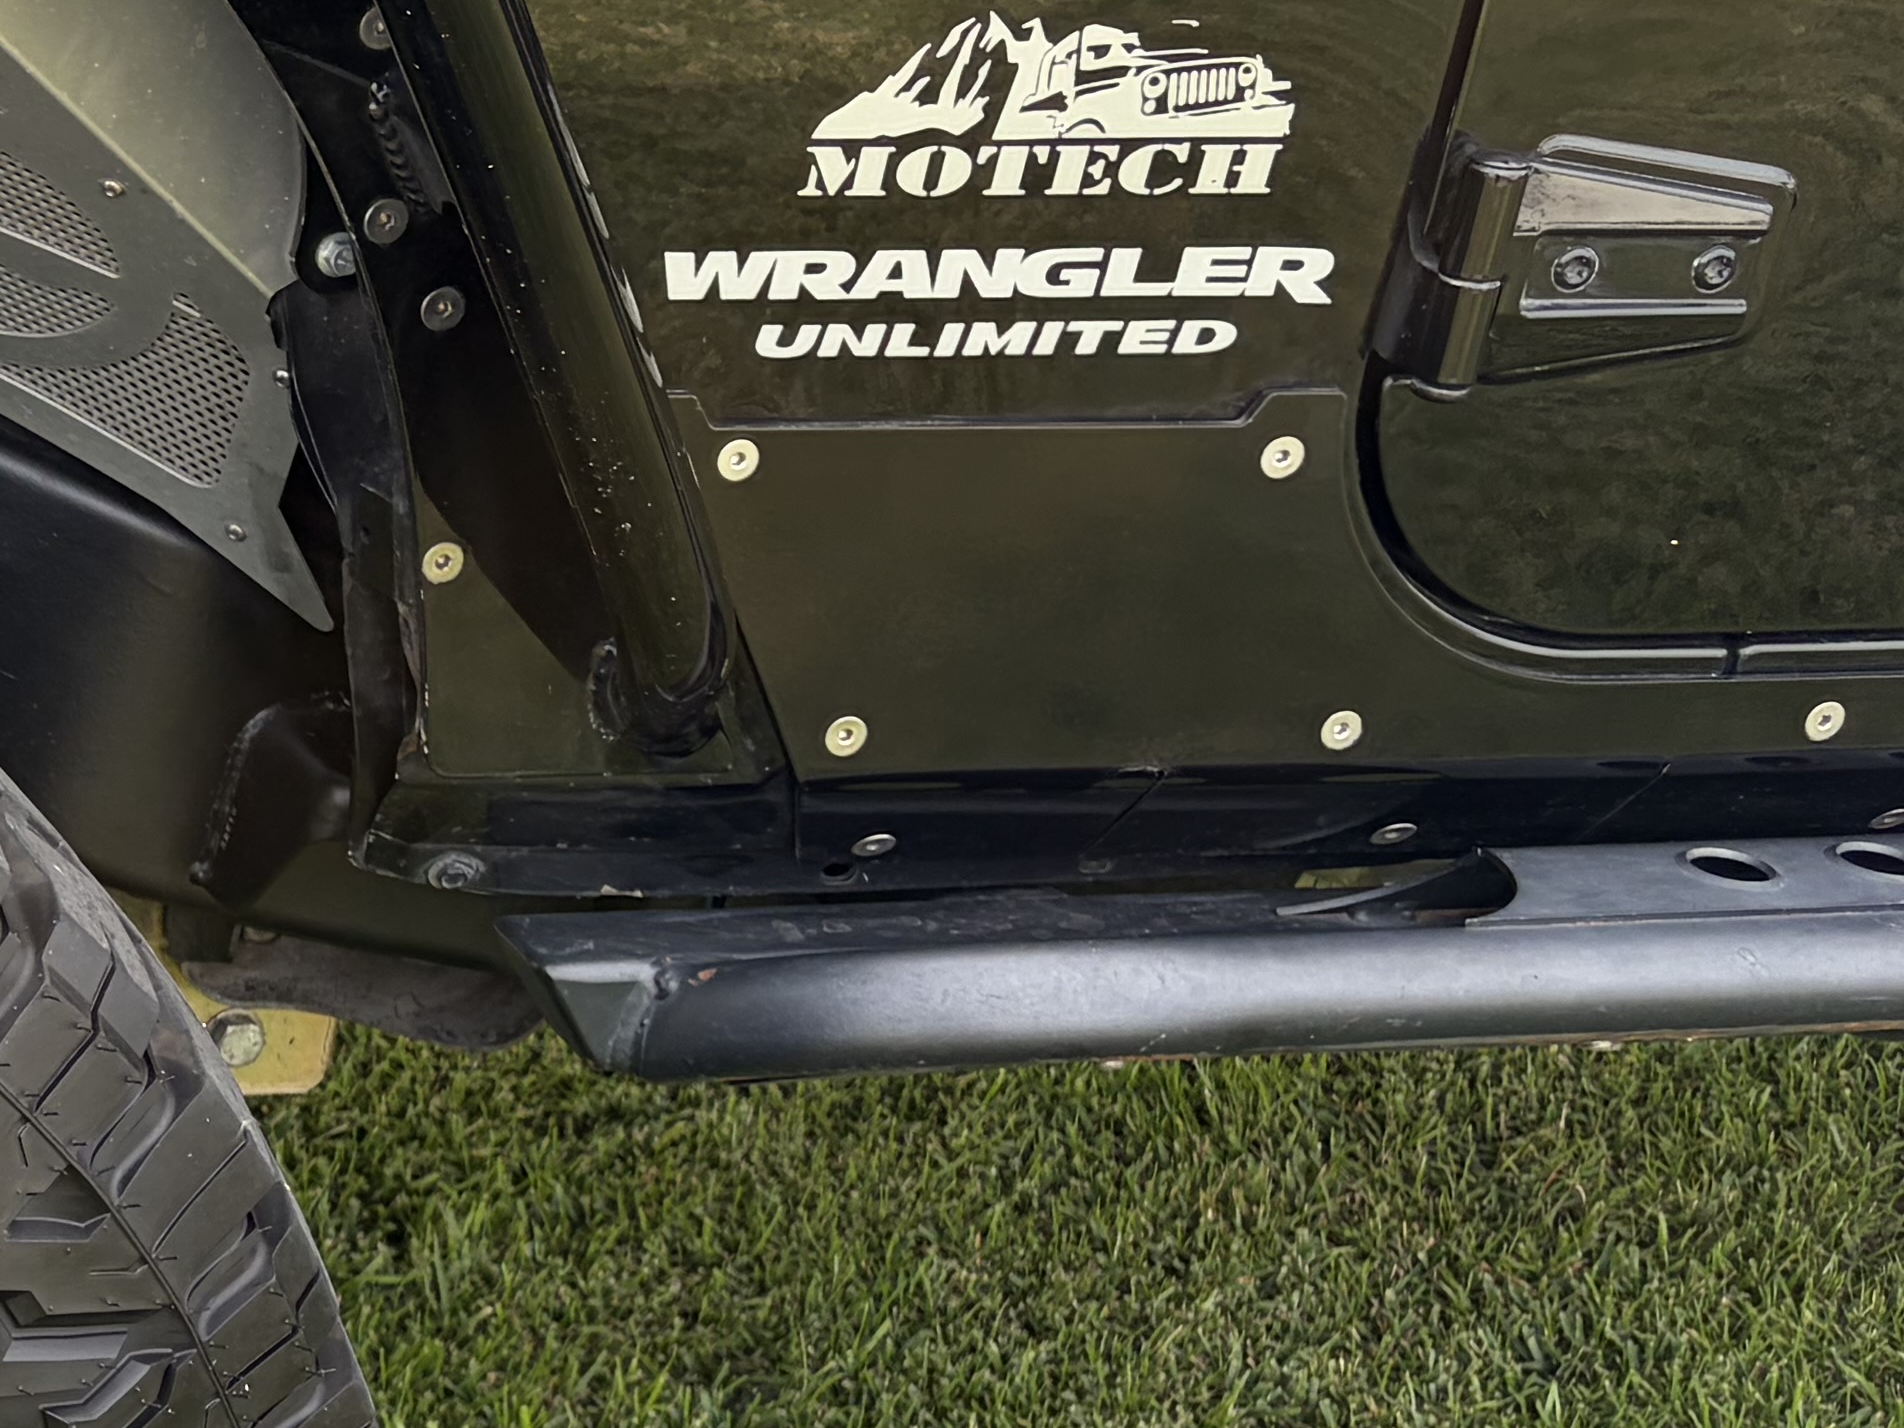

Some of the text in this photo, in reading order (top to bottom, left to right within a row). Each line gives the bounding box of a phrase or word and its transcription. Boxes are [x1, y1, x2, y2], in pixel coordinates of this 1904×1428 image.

[796, 141, 1285, 198] MOTECH
[663, 245, 1336, 305] WRANGLER
[754, 318, 1239, 359] UNLIMITED
